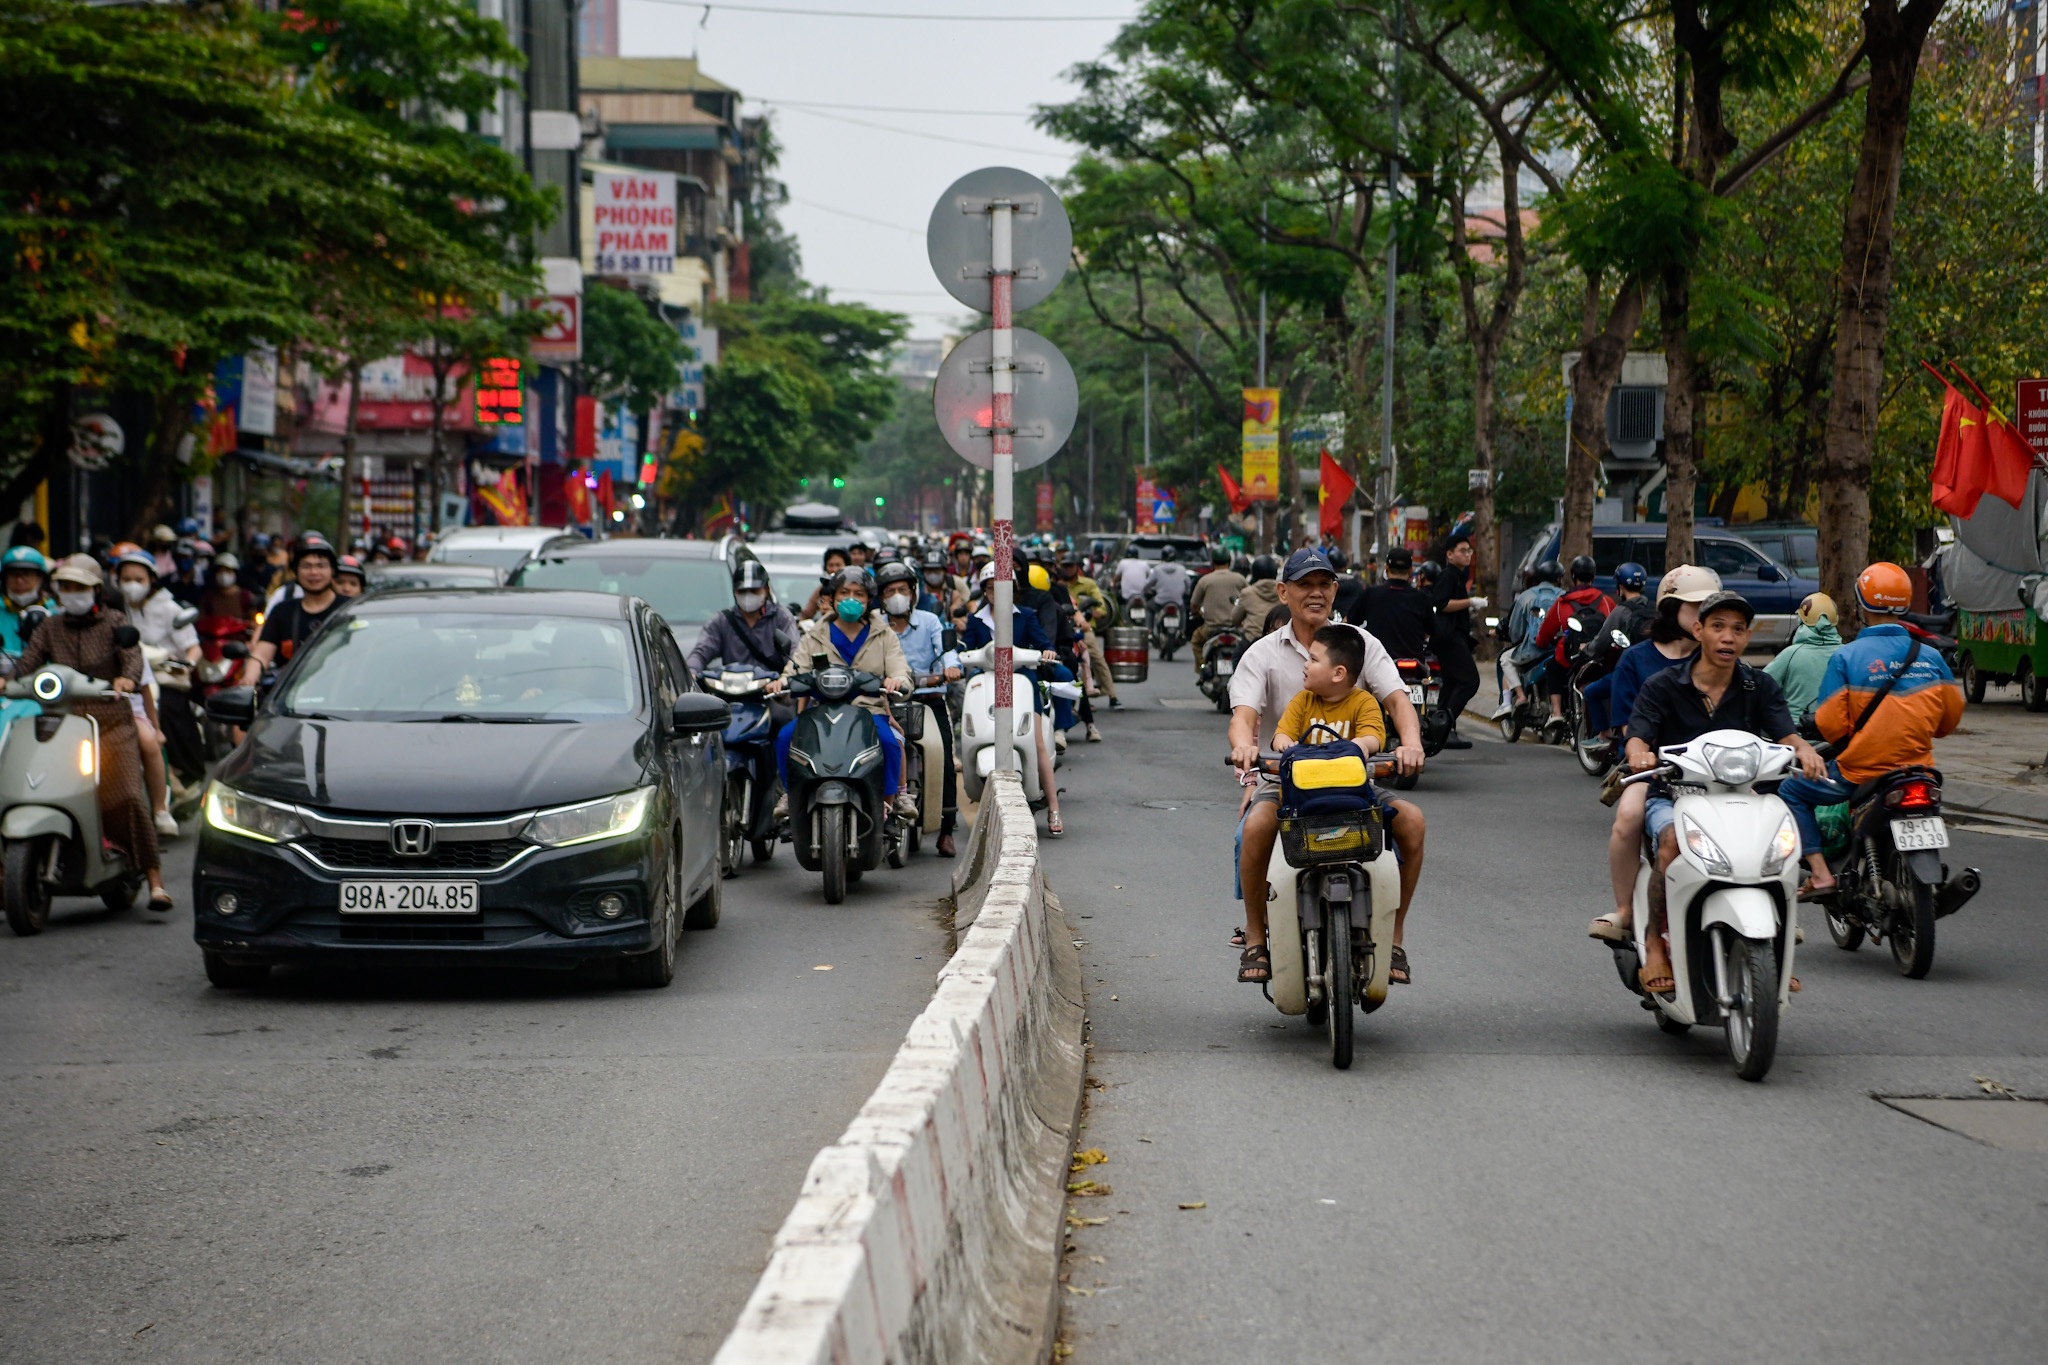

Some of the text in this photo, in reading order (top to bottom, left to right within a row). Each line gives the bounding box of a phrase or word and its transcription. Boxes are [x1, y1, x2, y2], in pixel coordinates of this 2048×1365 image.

[648, 255, 673, 273] TTT
[1900, 819, 1937, 834] 29-C1
[1899, 833, 1944, 848] 923.39
[345, 885, 473, 909] 98A-204.85
